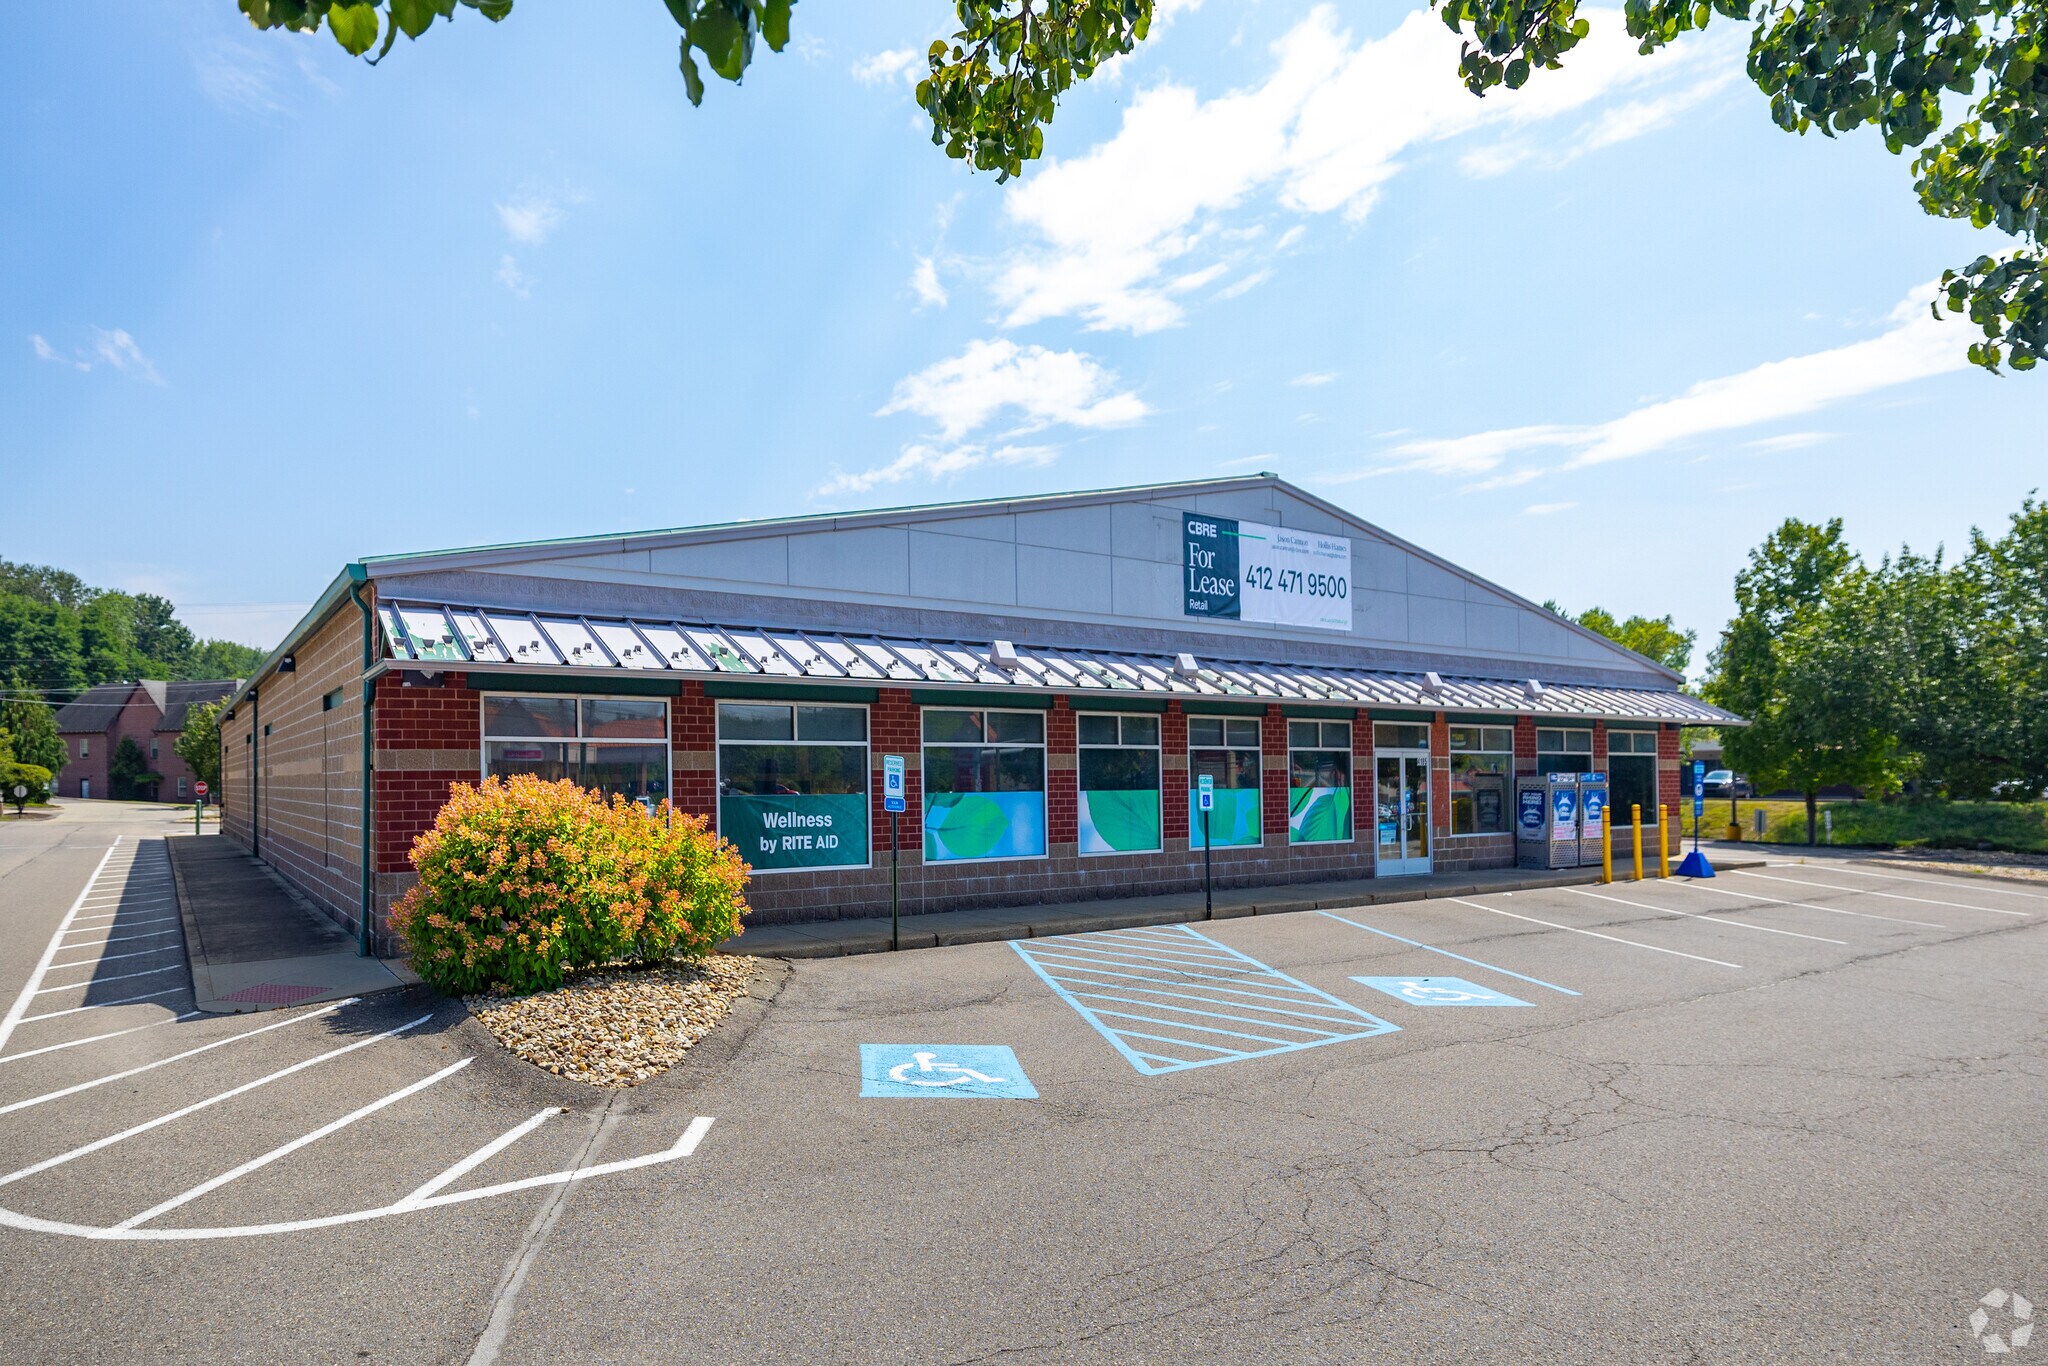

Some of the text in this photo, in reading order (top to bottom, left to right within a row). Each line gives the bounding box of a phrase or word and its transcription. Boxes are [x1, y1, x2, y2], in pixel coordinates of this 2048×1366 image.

[1188, 521, 1217, 537] CBRE
[1188, 542, 1215, 569] For
[1189, 568, 1235, 597] Lease
[1246, 565, 1347, 599] 412 471 9500
[1189, 599, 1208, 610] Retail
[763, 812, 833, 828] Wellness
[760, 835, 839, 854] by RITE AID
